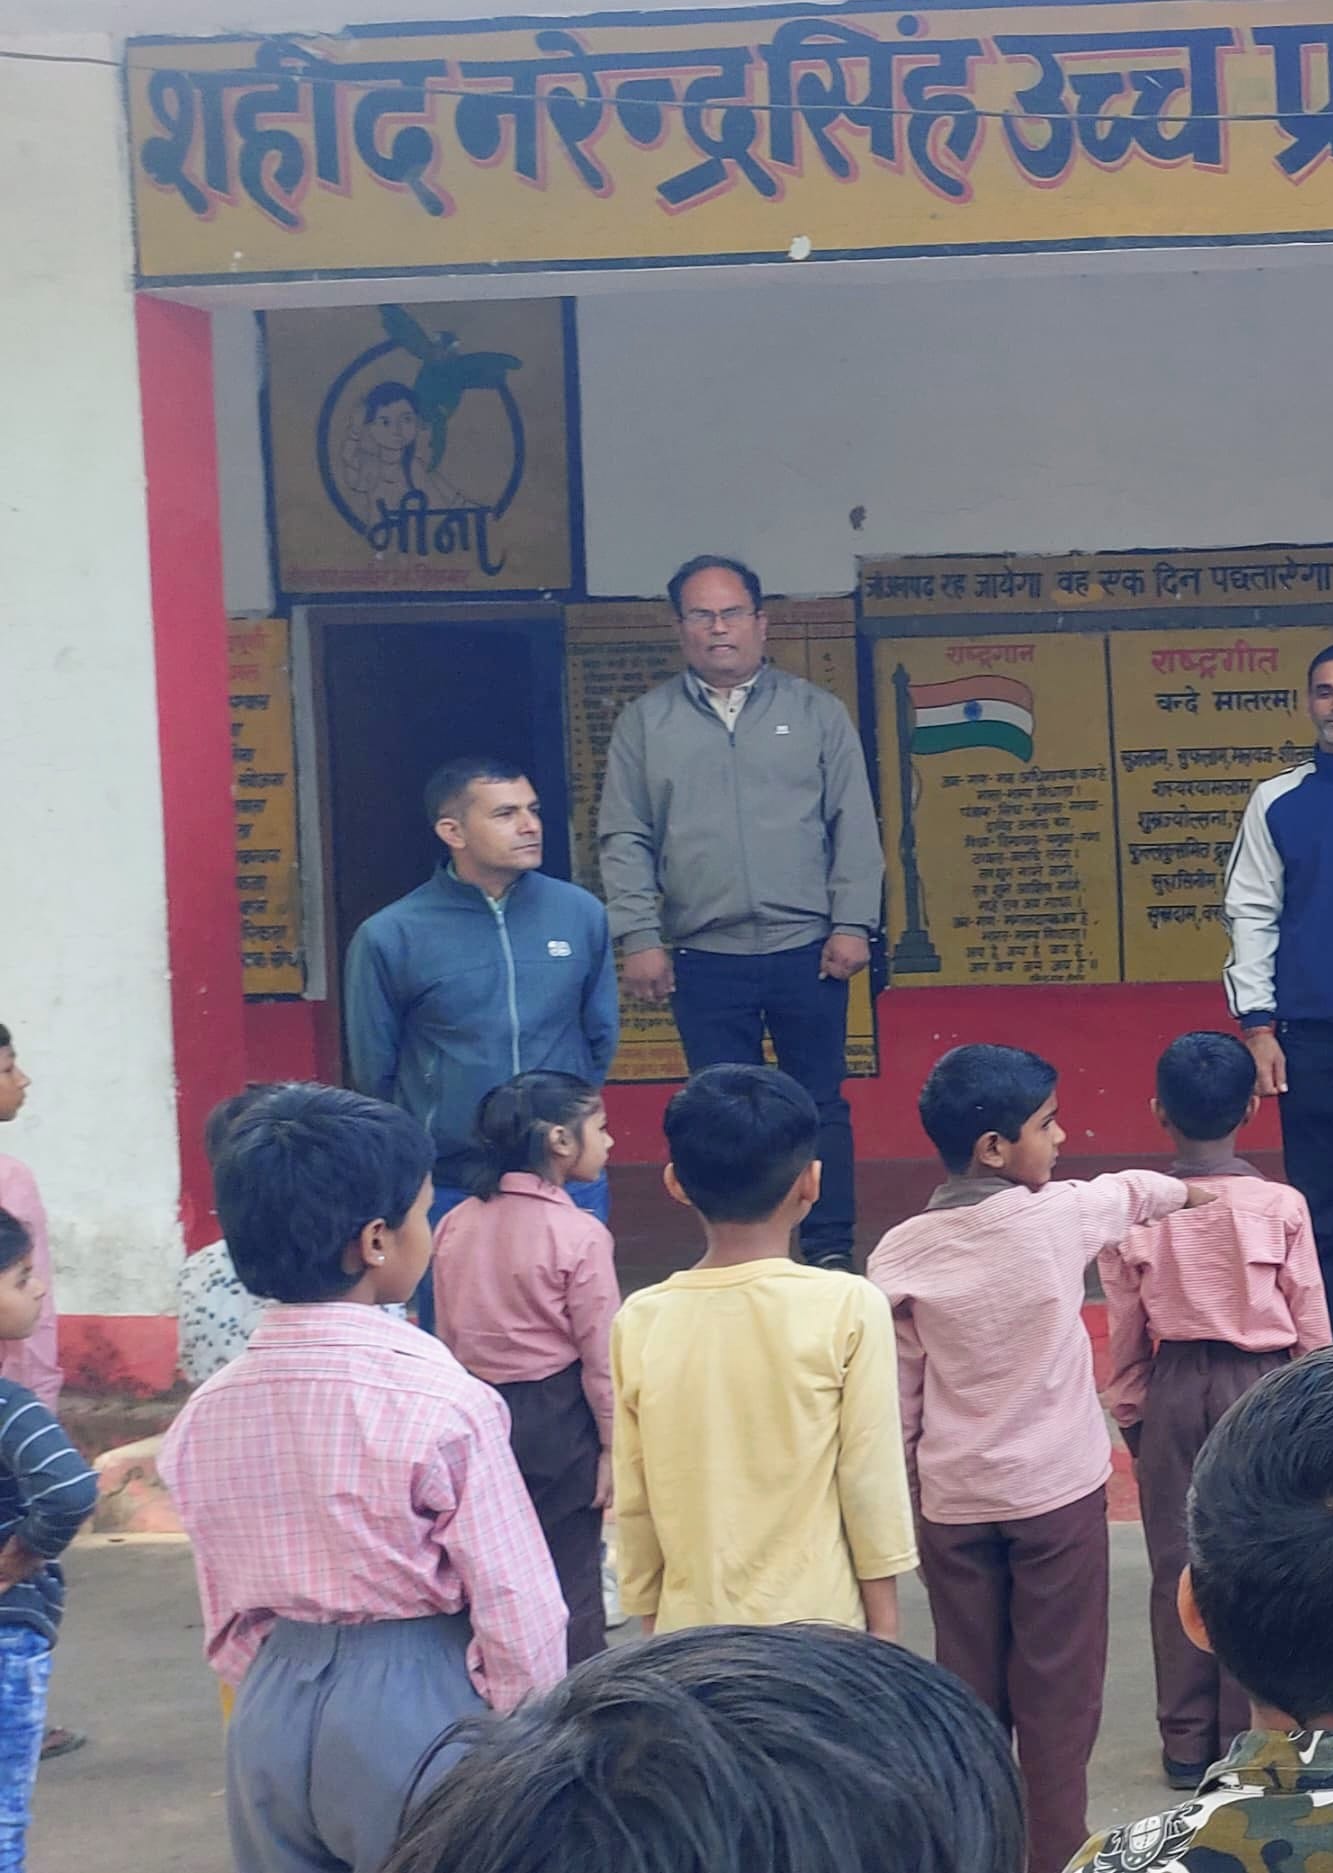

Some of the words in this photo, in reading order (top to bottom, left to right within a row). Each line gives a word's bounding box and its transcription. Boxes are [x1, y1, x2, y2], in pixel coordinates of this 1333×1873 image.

[142, 36, 458, 228] शहीद
[766, 14, 984, 196] सिंह
[997, 28, 1232, 180] उच्च
[366, 488, 506, 576] मीना
[1056, 570, 1091, 597] वह
[1097, 569, 1145, 597] एक
[1152, 561, 1203, 598] दिन
[1151, 639, 1280, 680] राष्ट्रगीत
[1155, 686, 1201, 714] वन्दे
